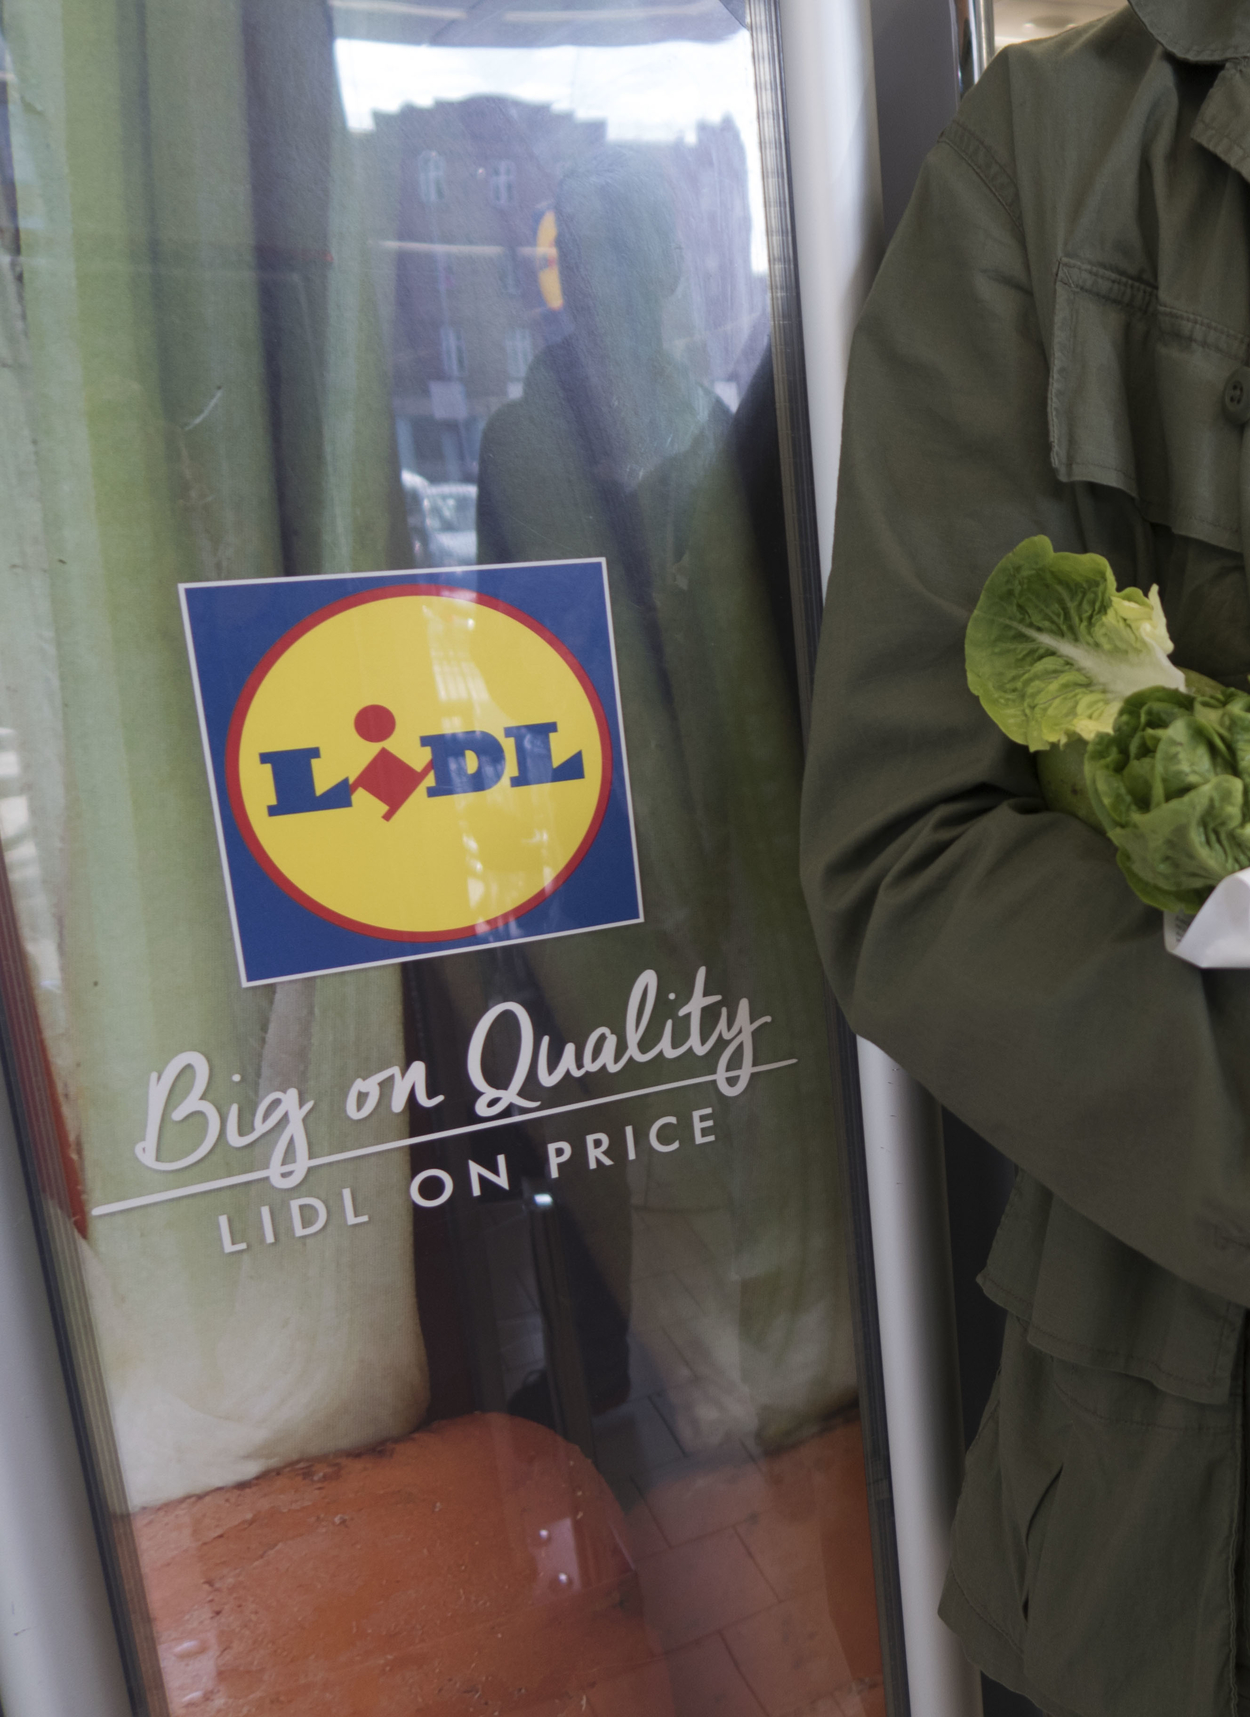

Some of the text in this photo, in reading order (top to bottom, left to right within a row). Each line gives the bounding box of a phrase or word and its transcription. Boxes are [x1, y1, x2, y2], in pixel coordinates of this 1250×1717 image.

[135, 965, 773, 1188] Big on Quality
[218, 1108, 716, 1254] LIDL ON PRICE
